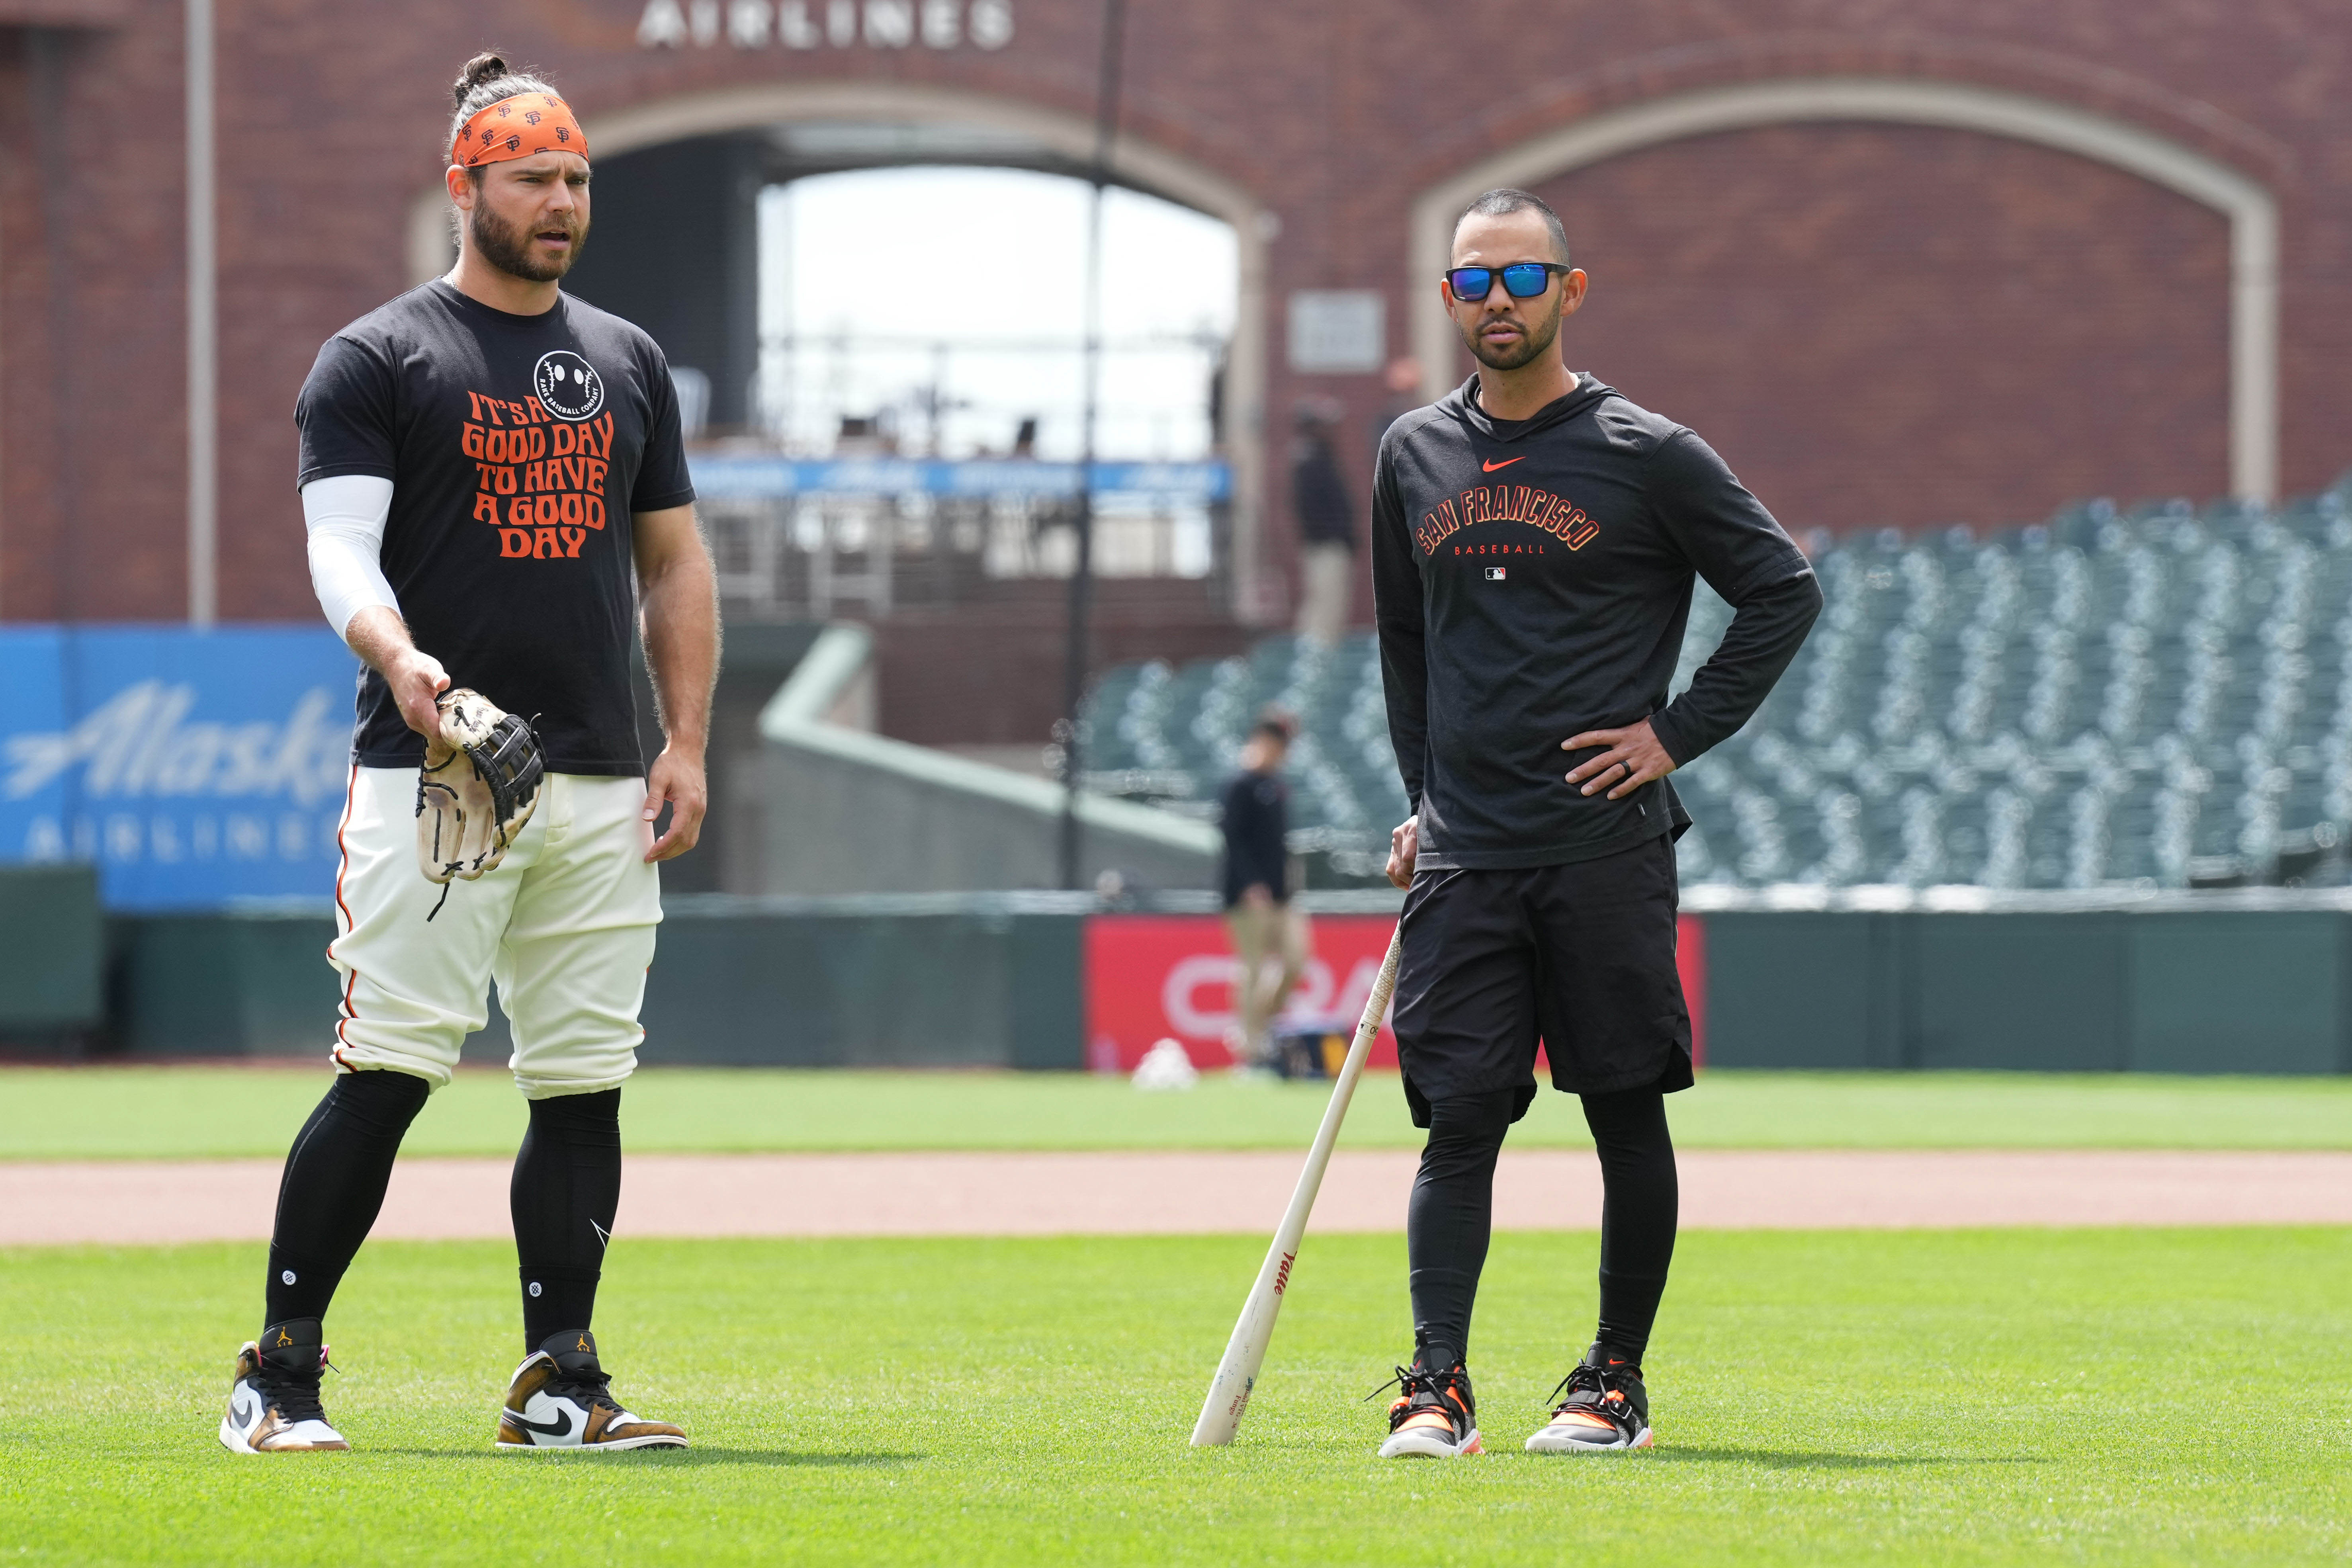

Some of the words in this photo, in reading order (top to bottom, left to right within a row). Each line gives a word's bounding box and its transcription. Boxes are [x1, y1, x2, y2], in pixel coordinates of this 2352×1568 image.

[637, 0, 1015, 49] AIRLINES
[467, 390, 529, 426] IT'S
[523, 395, 552, 424] A
[540, 378, 550, 397] RAKE
[547, 397, 580, 414] BASEBALL
[581, 387, 598, 413] COMPANY
[461, 420, 546, 463] GOOD
[551, 411, 614, 461] DAY
[476, 462, 517, 495] TO
[524, 457, 608, 497] HAVE
[473, 491, 502, 525] A
[508, 493, 606, 531] GOOD
[1416, 499, 1460, 555] SAN
[1460, 485, 1599, 551] FRANCISCO
[498, 528, 587, 559] DAY
[1455, 544, 1544, 555] BASEBALL
[1229, 1395, 1242, 1416] Fungo
